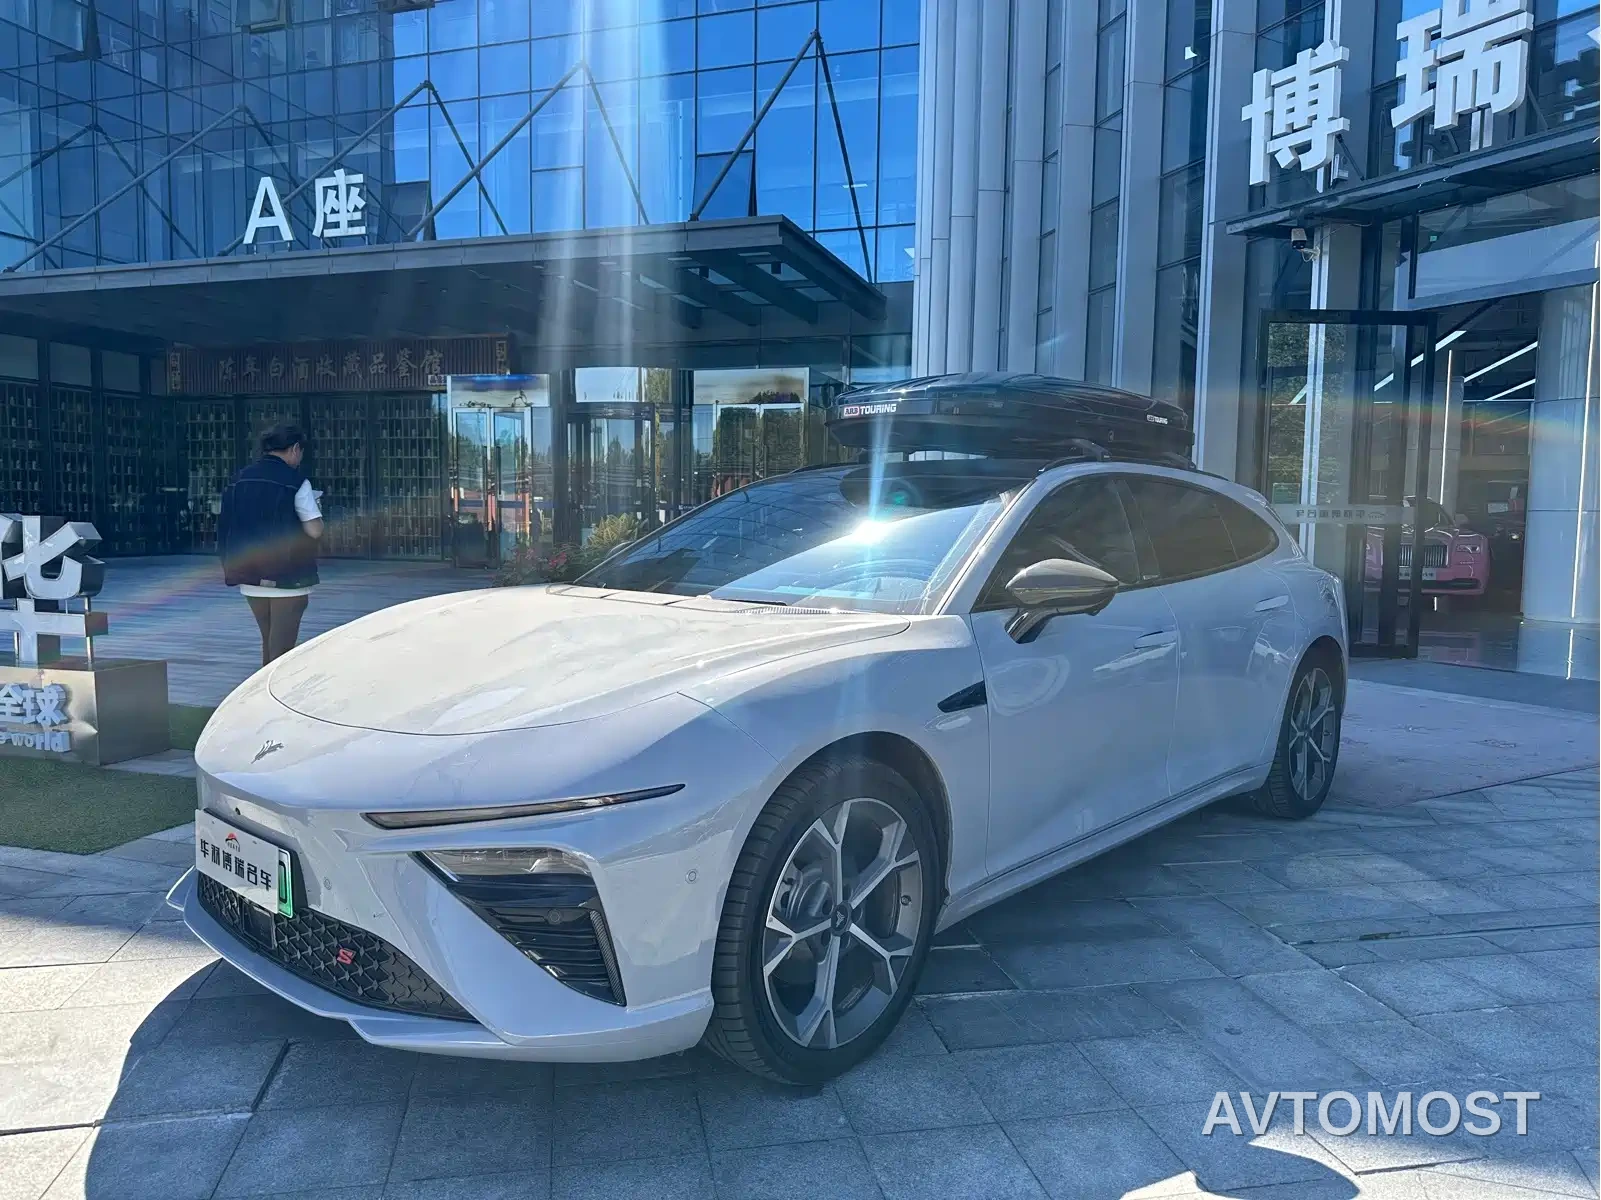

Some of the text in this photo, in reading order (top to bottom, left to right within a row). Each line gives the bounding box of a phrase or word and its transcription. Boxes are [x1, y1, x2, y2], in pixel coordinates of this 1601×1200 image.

[1241, 0, 1601, 186] 博瑞
[242, 168, 368, 244] A座
[860, 403, 897, 415] TOURING
[0, 683, 66, 725] 全球
[11, 731, 70, 752] world
